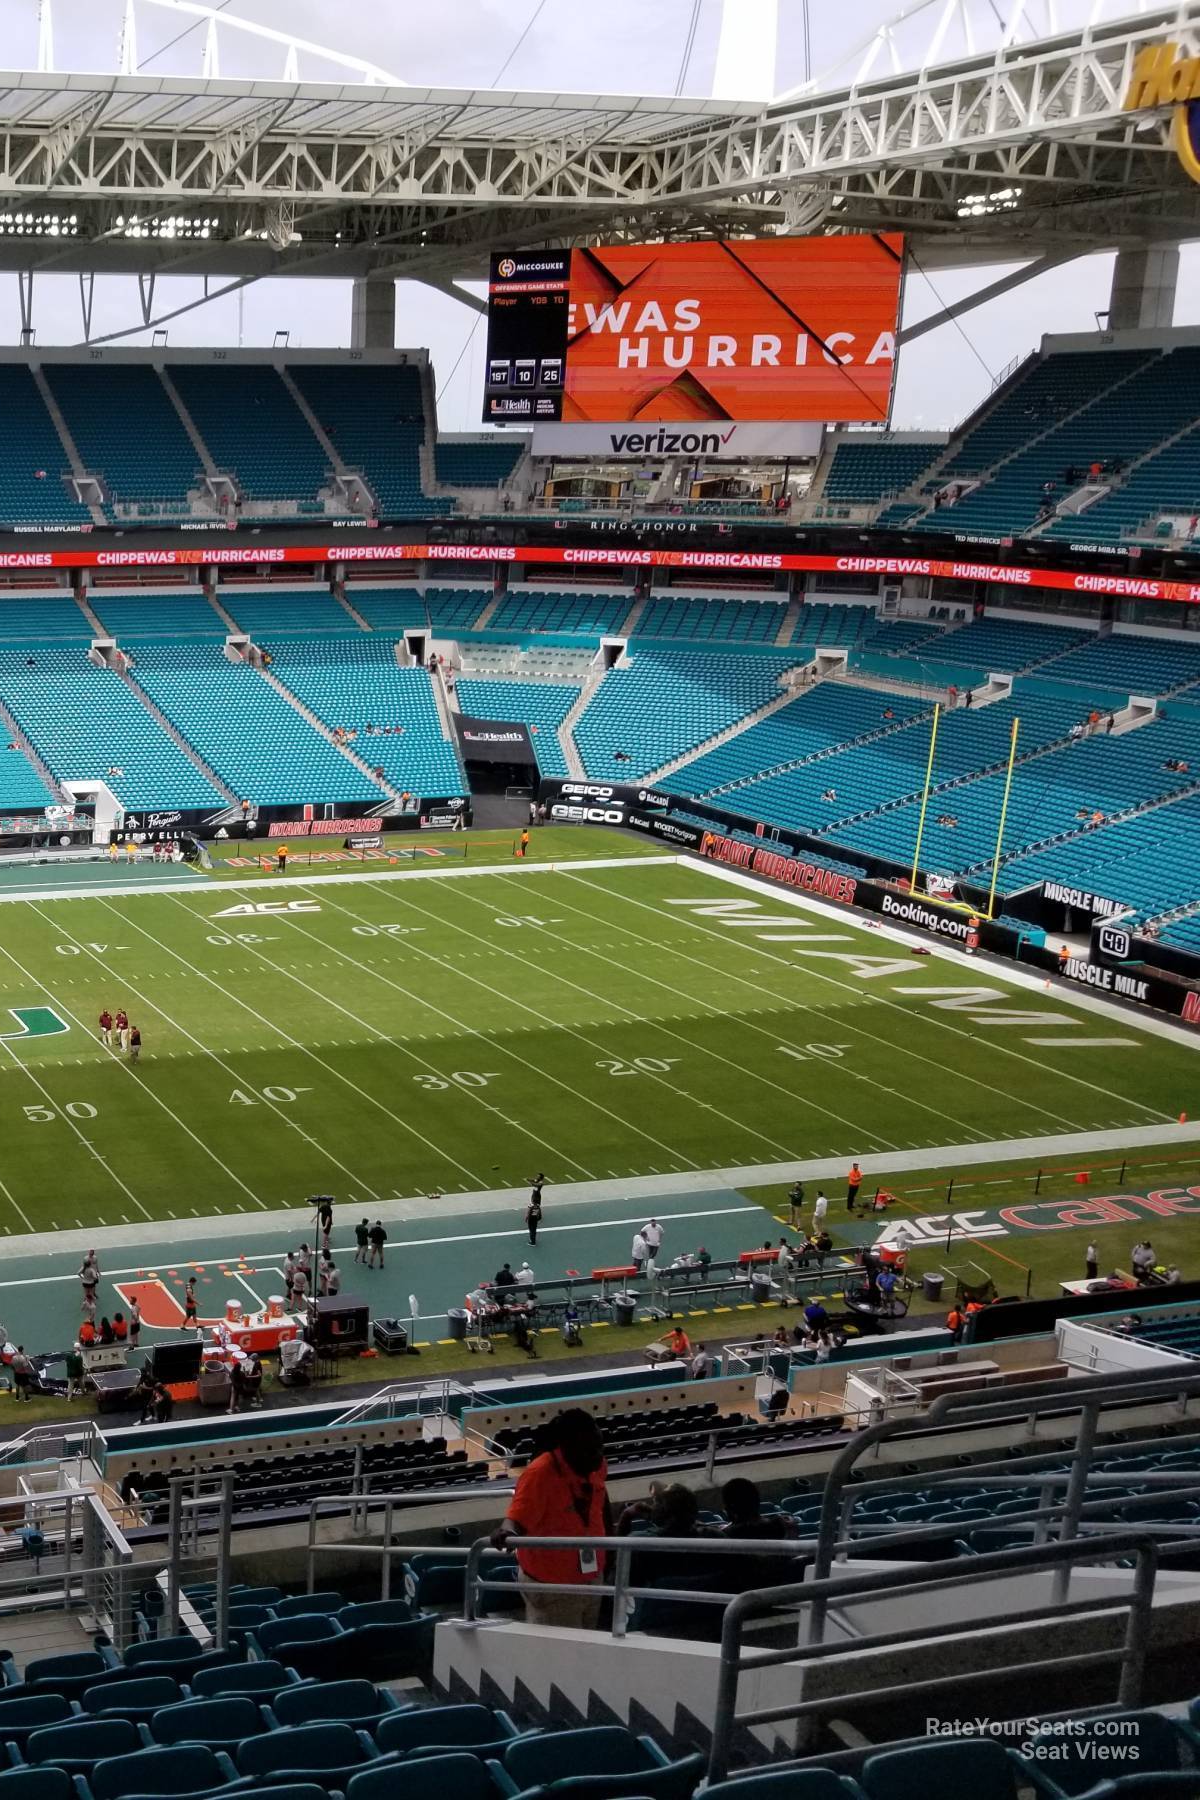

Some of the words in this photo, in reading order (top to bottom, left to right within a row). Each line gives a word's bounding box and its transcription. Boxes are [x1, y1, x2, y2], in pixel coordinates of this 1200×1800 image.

[516, 262, 564, 272] MICCOSUKEE
[528, 283, 545, 291] GAME
[546, 282, 564, 290] STATS
[494, 297, 517, 306] Player
[618, 331, 896, 369] HURRICA
[492, 372, 508, 382] 1ST
[519, 371, 531, 382] 10
[544, 371, 558, 381] 25
[609, 428, 719, 454] verizon
[877, 432, 895, 441] 327
[44, 525, 80, 533] MARYLAND
[181, 523, 208, 531] MICHAEL
[209, 522, 226, 530] IRVIN
[347, 520, 367, 528] LEWIS
[590, 521, 628, 531] RING
[642, 522, 697, 532] HONOR
[967, 535, 1000, 545] HENDRICKS
[97, 551, 176, 565] CHIPPEWAS
[202, 549, 285, 563] HURRICANES
[327, 547, 403, 560] CHIPPEWAS
[428, 546, 515, 560] HURRICANES
[563, 549, 651, 564] CHIPPEWAS
[682, 552, 782, 568] HURRICANES
[1070, 545, 1097, 553] GEORGE
[1098, 546, 1116, 555] MIRA
[837, 557, 930, 574] CHIPPEWAS
[953, 563, 1031, 583] HURRICANES
[1074, 575, 1159, 597] CHIPPEWAS
[561, 783, 614, 797] GEICO
[551, 804, 624, 824] GEICO
[268, 821, 311, 838] MIAMI
[310, 817, 383, 835] HURRICANES
[654, 821, 675, 834] ROCKET
[674, 827, 697, 842] Mortgage
[699, 830, 755, 870] MIAMI
[752, 848, 858, 905] HURRICANES
[210, 899, 322, 918] ACC
[1044, 882, 1090, 912] MUSCLE
[1092, 896, 1125, 917] MILK
[493, 914, 551, 928] 10
[882, 894, 970, 939] Booking.com
[207, 932, 262, 947] 30
[352, 923, 411, 937] 20
[55, 942, 110, 957] 40
[1104, 932, 1125, 955] 40
[662, 897, 1144, 1048] MIAMI
[1114, 974, 1147, 1001] MILK
[775, 1042, 843, 1063] 10
[594, 1056, 671, 1078] 20
[412, 1071, 487, 1092] 30
[228, 1086, 298, 1108] 40
[22, 1101, 98, 1123] 50
[870, 1211, 1011, 1251] ACC
